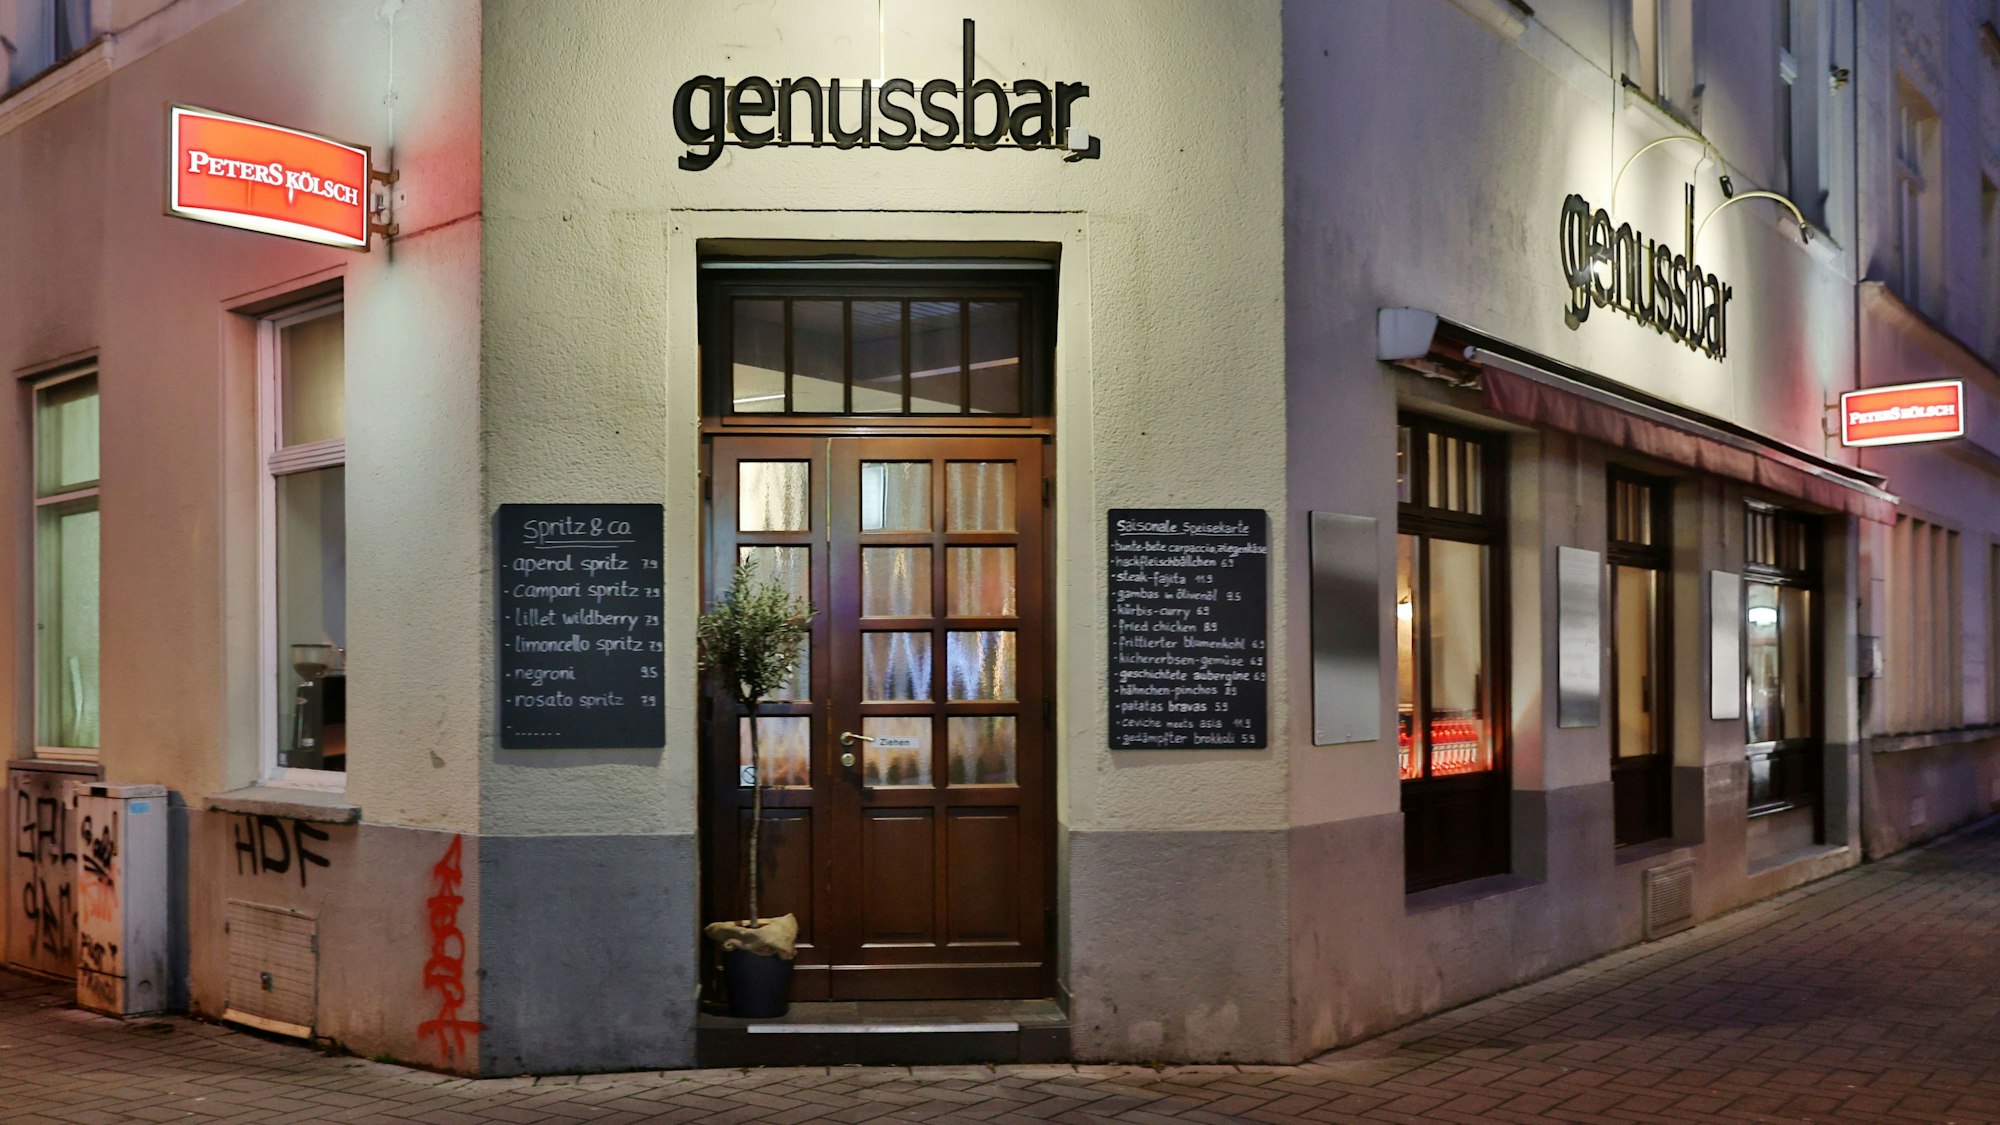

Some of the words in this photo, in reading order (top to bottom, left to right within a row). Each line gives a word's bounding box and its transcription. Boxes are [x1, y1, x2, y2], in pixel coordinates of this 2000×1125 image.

[673, 18, 1100, 171] genussbar
[1560, 181, 1732, 364] genussbar
[523, 516, 586, 544] Spritz
[590, 518, 603, 536] &
[1117, 519, 1177, 532] Saisonale
[1183, 520, 1250, 536] Speisekarte
[513, 554, 573, 577] aperol
[581, 553, 629, 577] spritz
[1116, 570, 1186, 586] steak-fajita
[588, 581, 639, 603] spritz
[1117, 587, 1159, 602] gambas
[515, 608, 556, 626] lillet
[562, 609, 639, 631] wildberry
[1117, 603, 1191, 620] kürbis-curry
[1119, 619, 1149, 634] fried
[1153, 620, 1197, 632] chicken
[515, 634, 590, 652] limoncello
[596, 636, 644, 656] spritz
[1184, 636, 1245, 649] blumenkohl
[1119, 652, 1244, 669] kichererbsen-gemüse
[514, 667, 576, 686] negroni
[1119, 669, 1187, 683] geschichtete
[1193, 670, 1250, 686] aubergine
[514, 691, 573, 707] rosato
[579, 692, 624, 709] spritz
[1121, 700, 1163, 714] patatas
[1168, 700, 1208, 712] bravas
[1122, 718, 1162, 728] ceviche
[1200, 718, 1223, 728] asia
[879, 738, 911, 746] Ziehen
[235, 815, 330, 888] HDF
